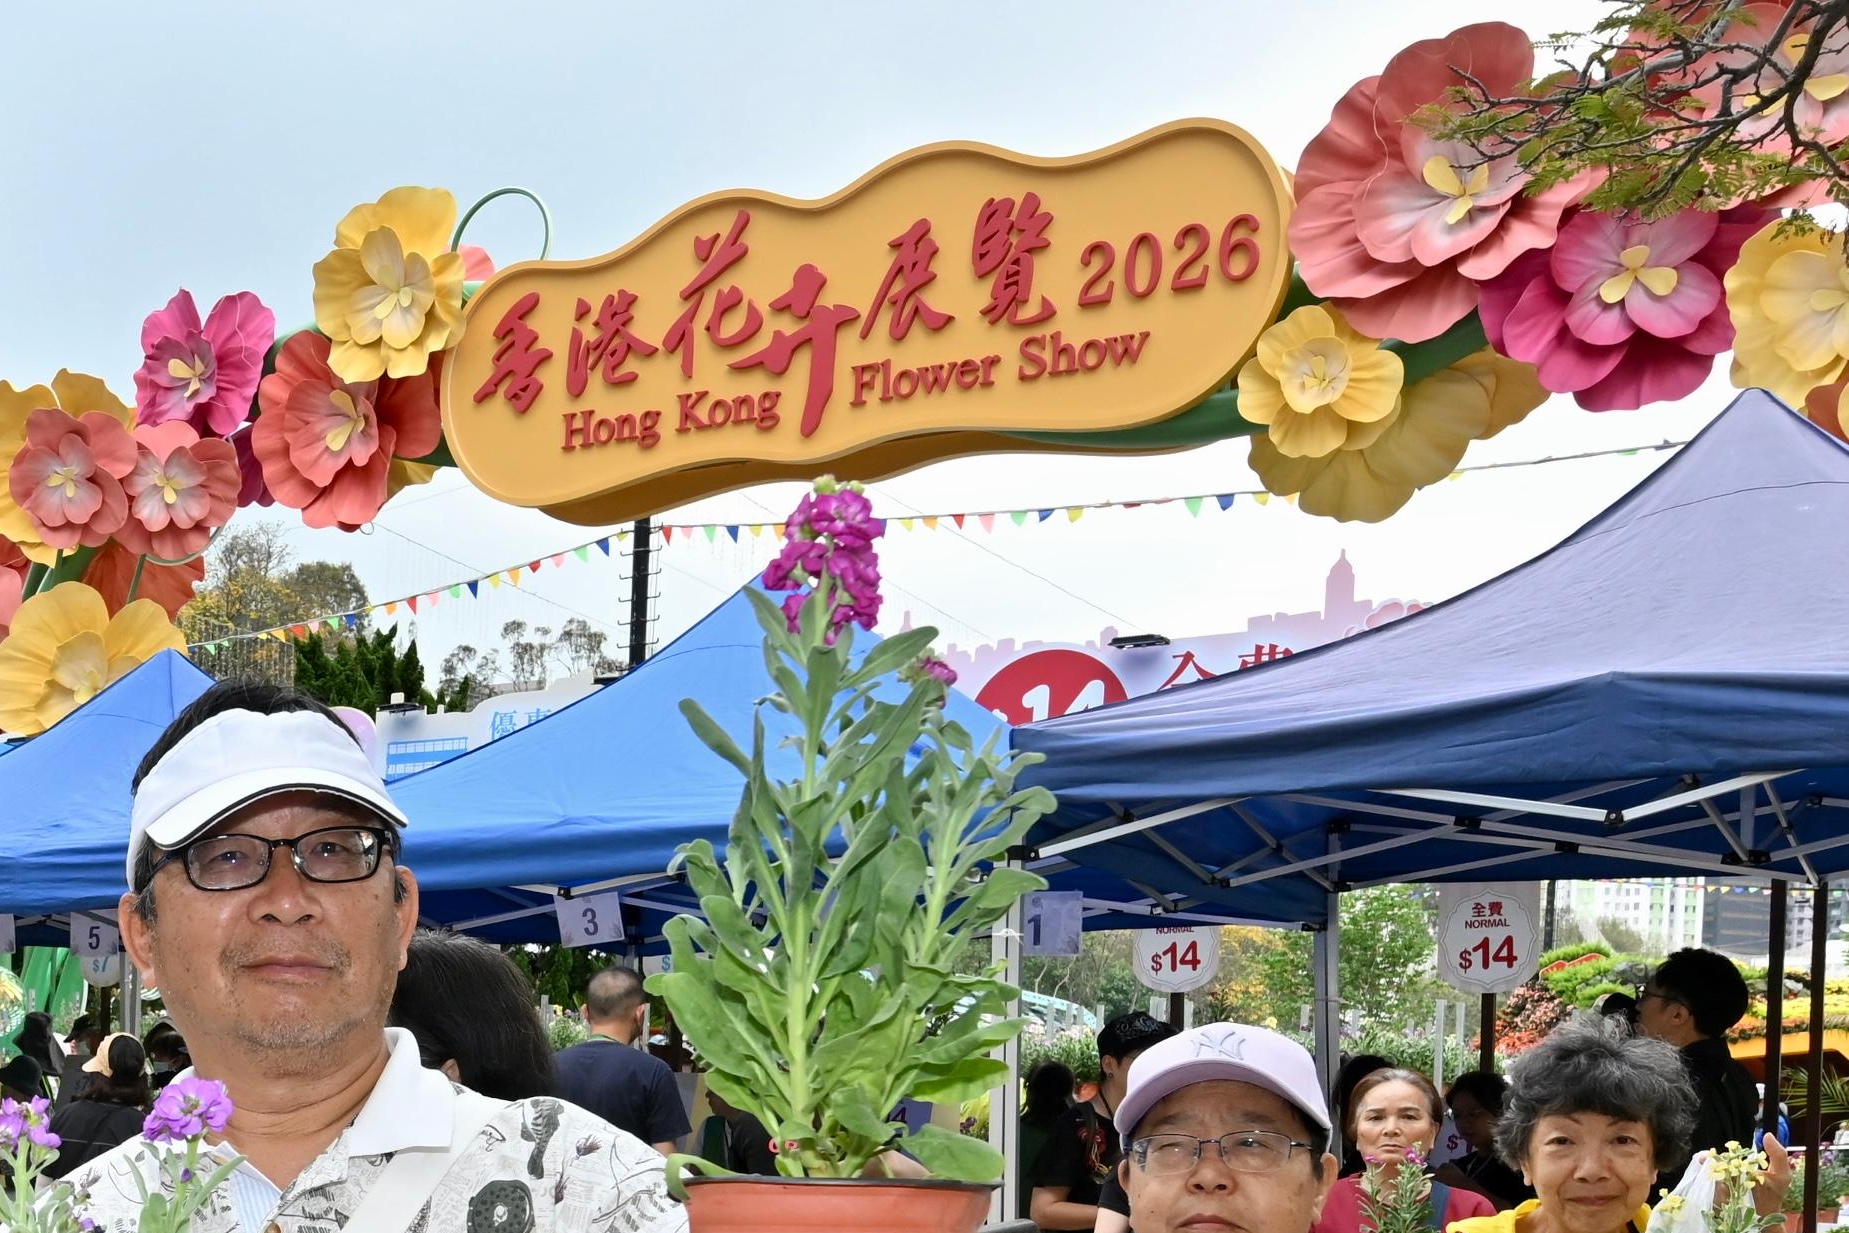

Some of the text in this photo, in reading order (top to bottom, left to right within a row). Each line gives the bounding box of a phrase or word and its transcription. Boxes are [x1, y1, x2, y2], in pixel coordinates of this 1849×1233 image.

[473, 191, 1261, 438] 香港花卉展覽 2026
[561, 330, 1150, 449] Hong Kong Flower Show
[581, 907, 599, 936] 3
[1464, 918, 1511, 929] NORMAL
[1472, 901, 1503, 918] 全費
[88, 926, 101, 950] 5
[1027, 914, 1042, 946] 1
[1150, 940, 1202, 975] $14
[1458, 934, 1519, 974] $14
